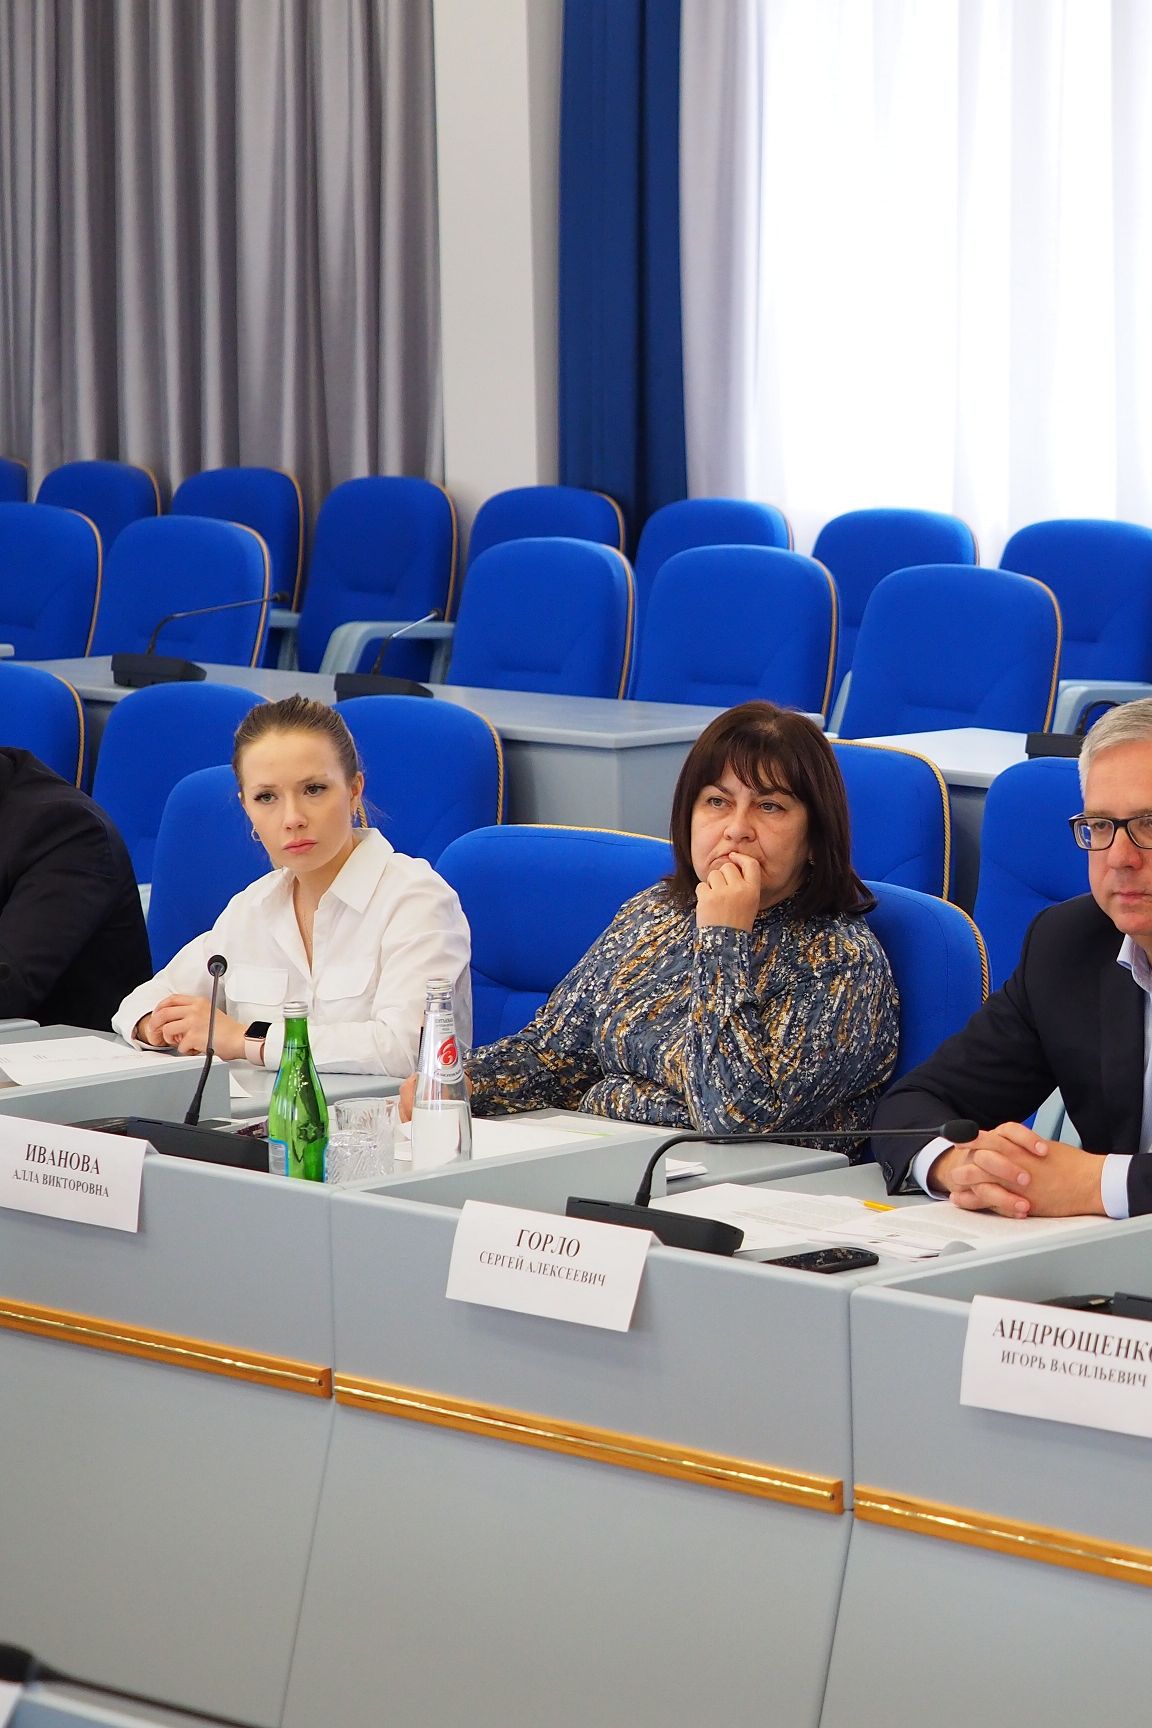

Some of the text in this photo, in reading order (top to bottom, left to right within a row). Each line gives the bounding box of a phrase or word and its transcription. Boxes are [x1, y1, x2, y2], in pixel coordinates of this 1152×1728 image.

[25, 1143, 100, 1175] ИВАНОВА
[12, 1169, 109, 1197] АЛЛА ВИКТОРОВНА
[515, 1228, 581, 1258] ГОРЛО
[479, 1250, 606, 1287] СЕРГЕЙ АЛЕКСЕЕВИЧ
[1001, 1350, 1148, 1388] ИГОРЬ ВАСИЛЬЕВИЧ
